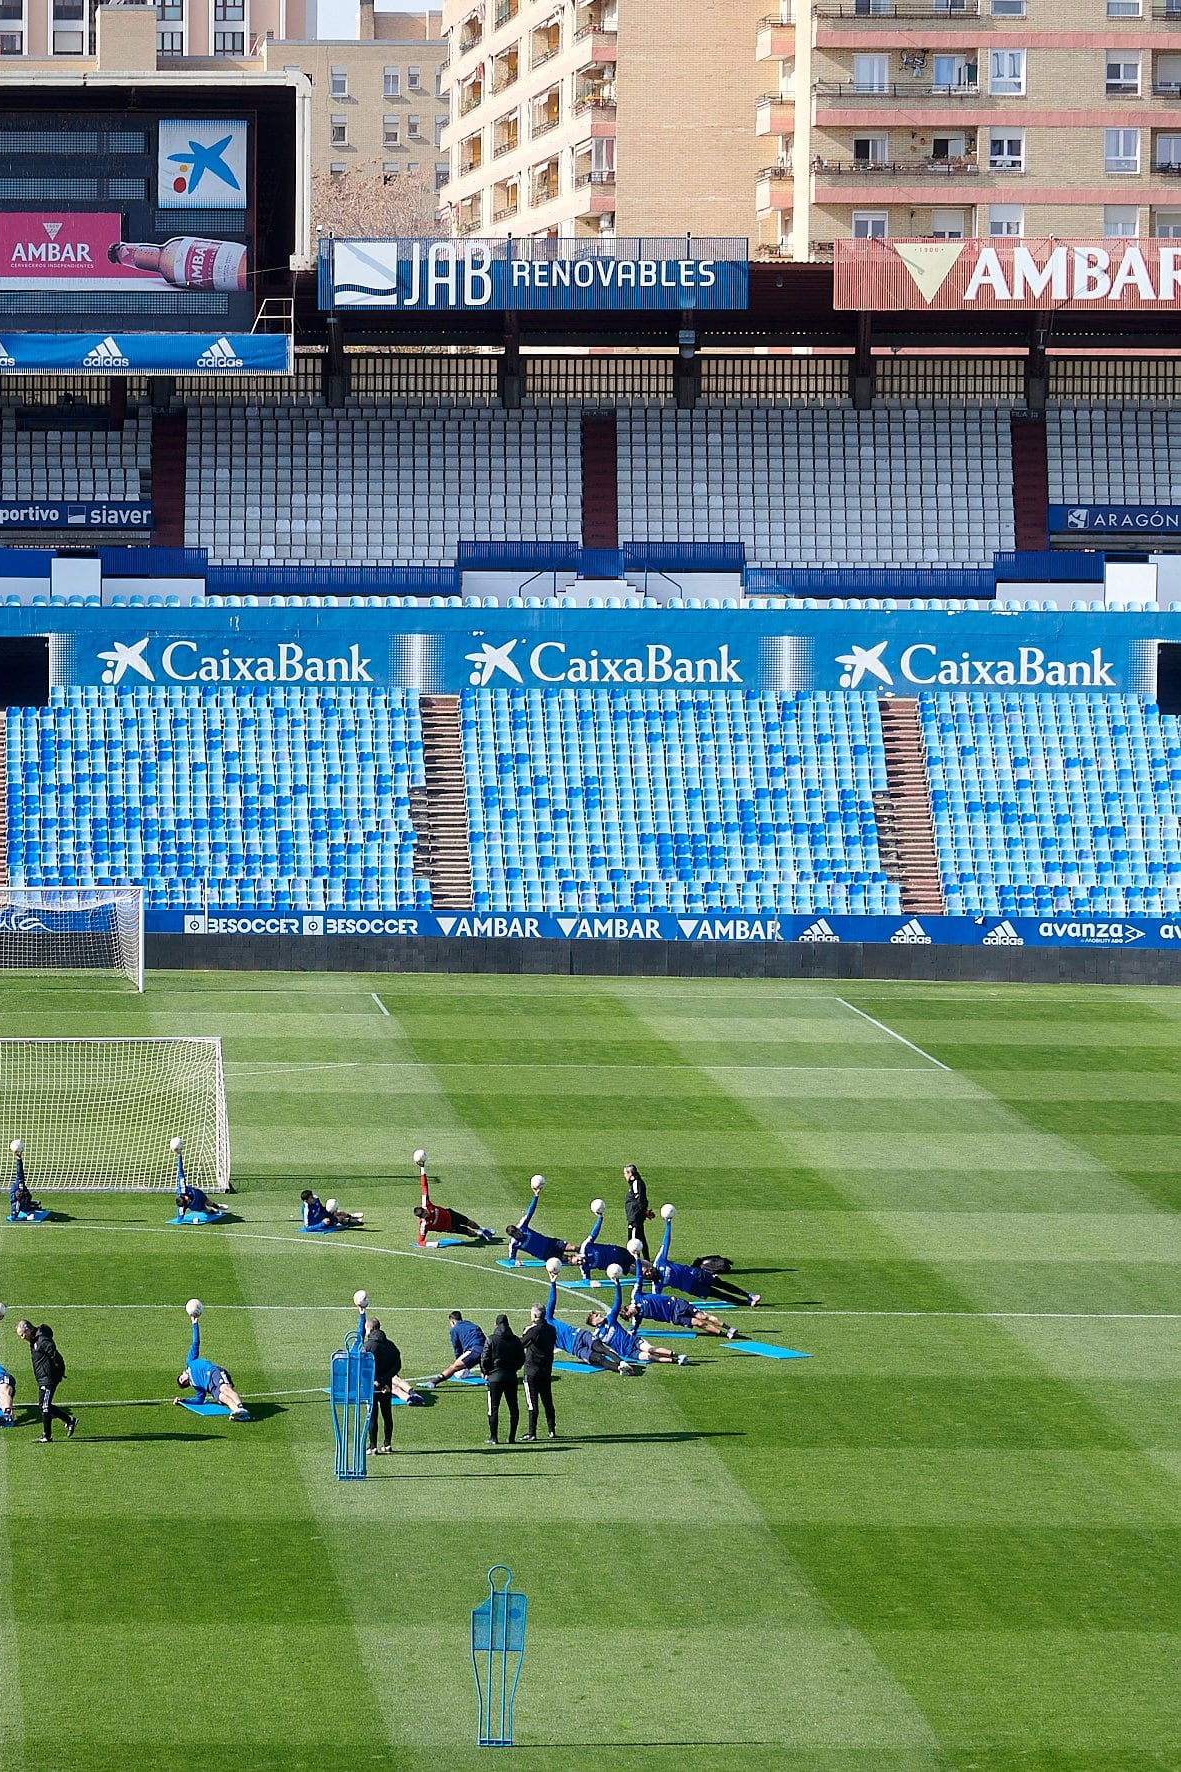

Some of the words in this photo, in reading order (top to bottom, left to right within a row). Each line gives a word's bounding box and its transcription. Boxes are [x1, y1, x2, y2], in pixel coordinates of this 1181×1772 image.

[11, 243, 93, 262] AMBAR
[404, 242, 492, 305] JAB
[511, 260, 716, 287] RENOVABLES
[83, 356, 129, 367] adidas
[197, 357, 243, 368] adidas
[90, 505, 152, 524] siaver
[1094, 510, 1179, 527] ARAGÓN
[162, 640, 374, 682] CaixaBank
[529, 641, 743, 684] CaixaBank
[900, 644, 1117, 686] CaixaBank
[208, 918, 300, 934] BESOCCER
[326, 919, 418, 935] BESOCCER
[455, 917, 542, 938] AMBAR
[577, 918, 663, 939] AMBAR
[698, 919, 784, 941] AMBAR
[1039, 922, 1124, 938] avanza
[798, 933, 840, 942] adidas
[890, 933, 932, 944] adidas
[982, 935, 1024, 946] adidas
